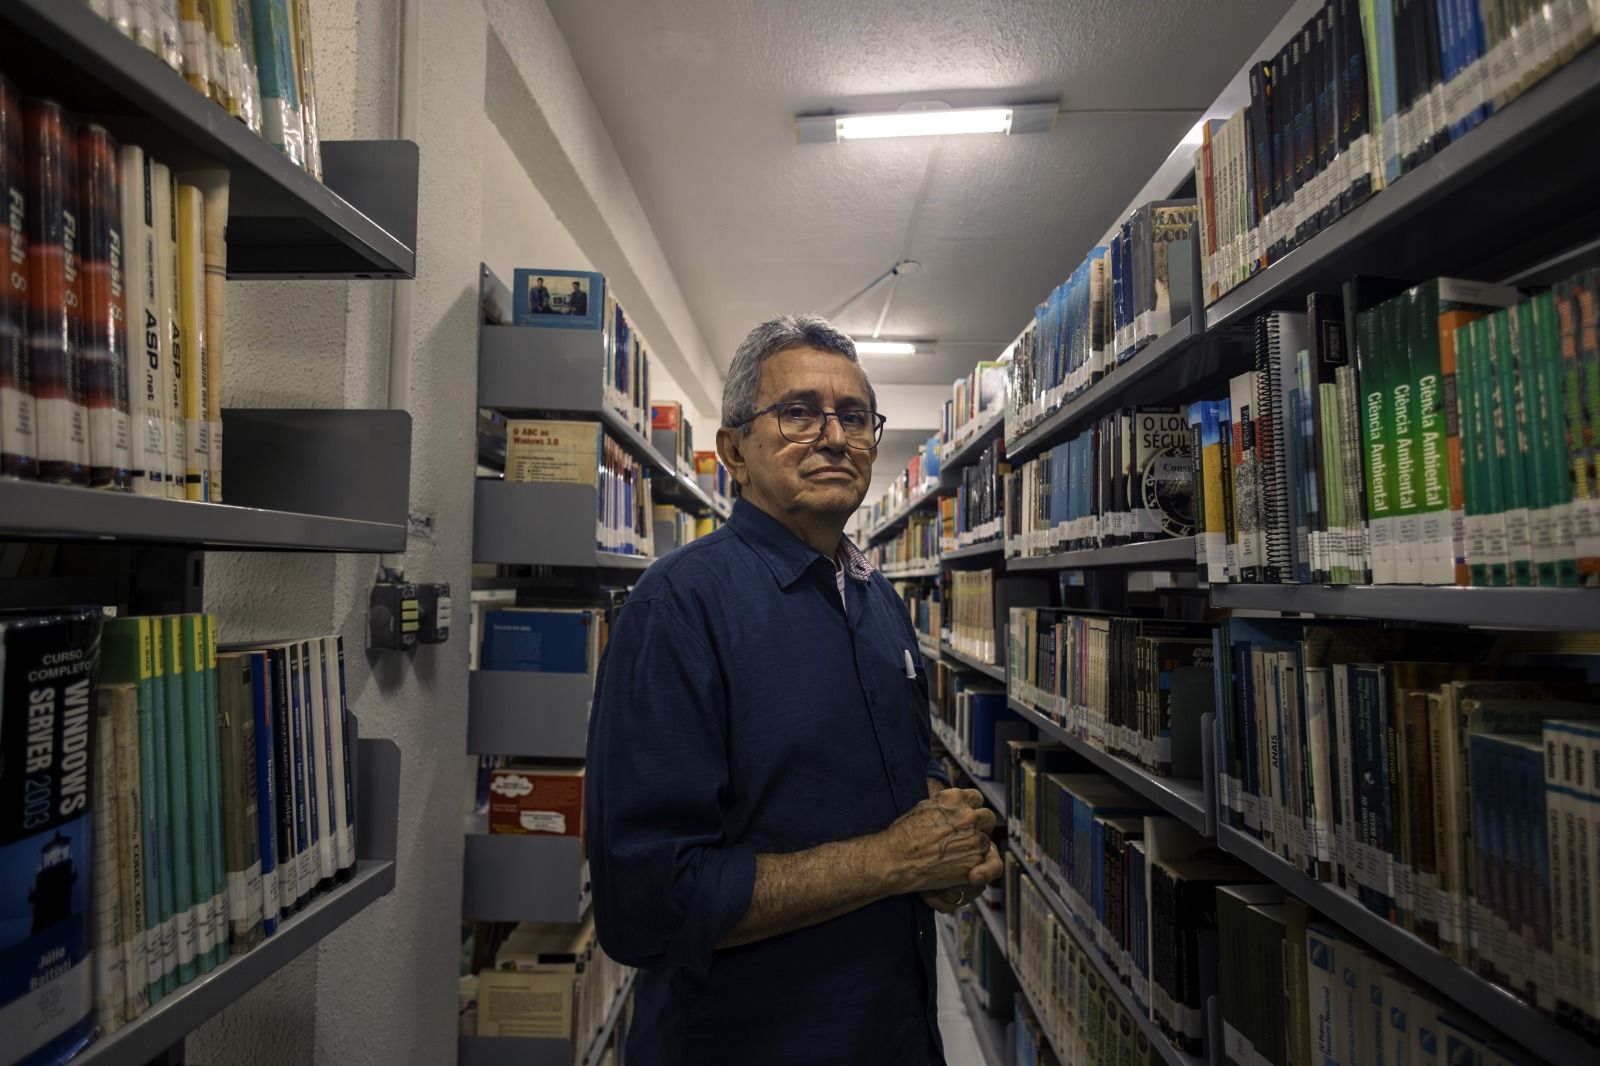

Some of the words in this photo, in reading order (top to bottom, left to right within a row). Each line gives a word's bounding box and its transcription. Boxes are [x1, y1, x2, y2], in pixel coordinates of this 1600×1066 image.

[9, 187, 26, 264] Flash
[63, 210, 78, 283] Flash
[11, 272, 27, 291] 8
[110, 228, 122, 297] Flash
[65, 291, 78, 308] 8
[113, 304, 122, 321] 8
[145, 308, 159, 402] ASP.net
[172, 321, 184, 410] ASP.net
[1143, 417, 1155, 431] O
[1367, 391, 1384, 440] Ciência
[1394, 384, 1412, 435] Ciência
[1419, 375, 1439, 428] Ciência
[513, 437, 544, 445] Windows
[522, 428, 538, 436] ABC
[1242, 410, 1251, 447] Previsão
[1370, 444, 1389, 512] Ambiental
[1396, 439, 1416, 509] Ambiental
[1422, 432, 1443, 507] Ambiental
[27, 661, 92, 682] COMPLETO
[42, 650, 84, 665] CURSO
[26, 687, 56, 774] SERVER
[59, 678, 90, 817] WINDOWS
[24, 774, 53, 830] 2003
